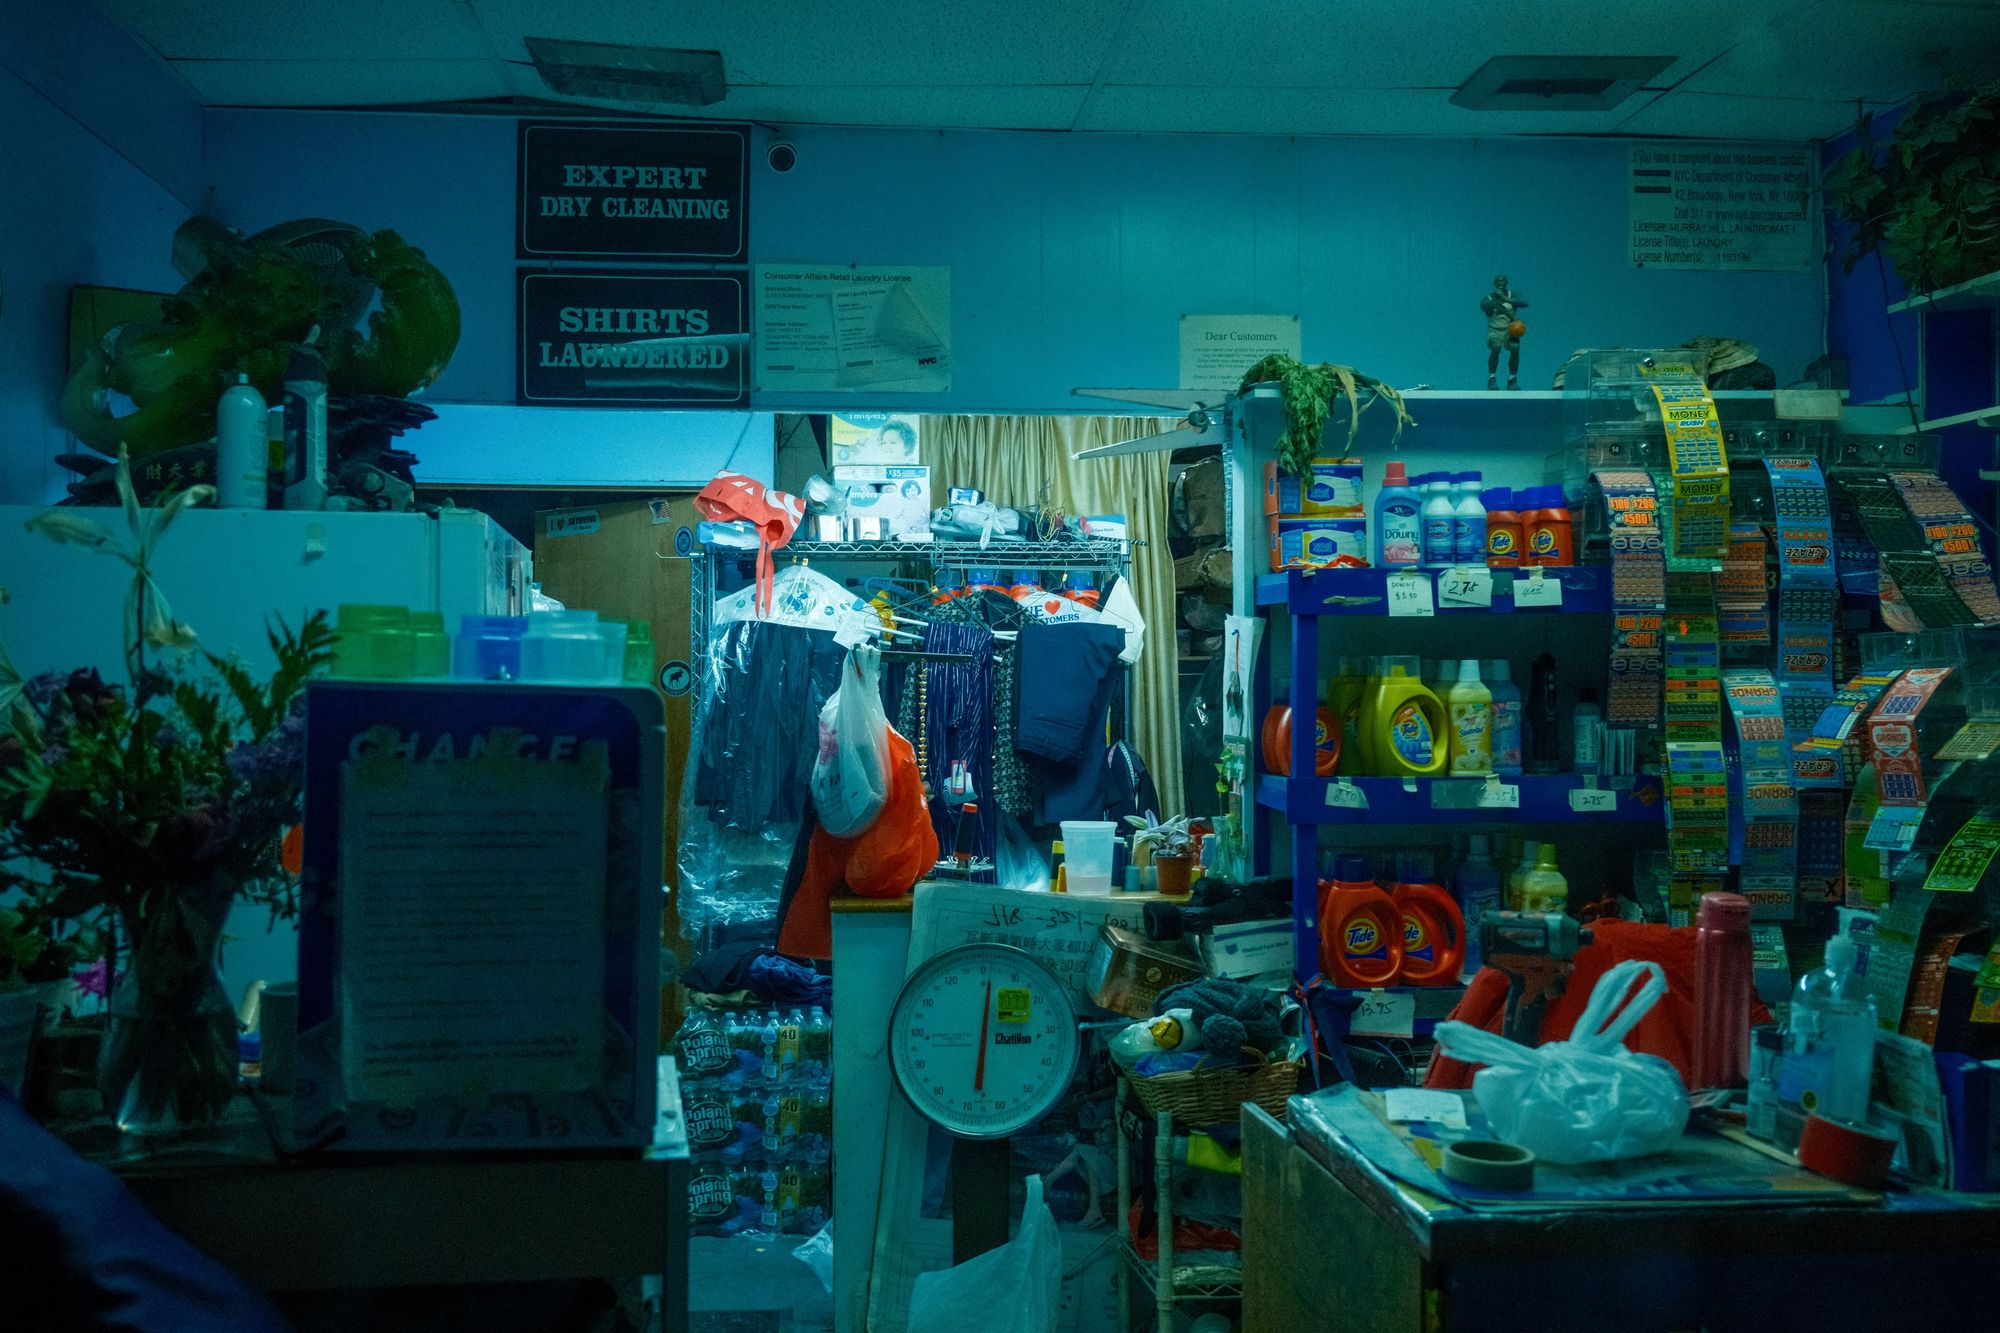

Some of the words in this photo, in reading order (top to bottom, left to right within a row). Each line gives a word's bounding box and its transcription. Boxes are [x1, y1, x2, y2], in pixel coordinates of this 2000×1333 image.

[563, 165, 706, 189] EXPERT
[1674, 170, 1690, 182] NYC
[1692, 170, 1734, 184] Department
[1745, 172, 1781, 184] Consumer
[1674, 189, 1684, 200] 42
[1728, 191, 1745, 201] New
[1768, 191, 1779, 201] NY
[541, 196, 591, 217] DRY
[602, 197, 730, 220] CLEANING
[1669, 223, 1706, 233] MURRAY
[1709, 224, 1726, 233] HILL
[1729, 224, 1790, 233] LAUNDROMAT
[1633, 235, 1662, 247] License
[1692, 239, 1735, 248] LAUNDRY
[1633, 251, 1661, 262] License
[765, 272, 803, 280] Consumer
[829, 273, 850, 281] Retail
[852, 274, 880, 283] Laundry
[560, 307, 709, 334] SHIRTS
[1205, 331, 1228, 341] Dear
[1229, 330, 1278, 341] Customers
[540, 342, 729, 369] LAUNDERED
[1670, 410, 1709, 419] MONEY
[1680, 484, 1722, 494] MONEY
[1609, 498, 1630, 510] $100
[1632, 497, 1655, 509] $200
[1688, 495, 1714, 503] RUSH
[1624, 513, 1653, 525] $500!
[1385, 528, 1418, 542] Downy
[1951, 525, 1974, 536] $200
[1490, 535, 1510, 549] Tide
[1943, 540, 1974, 552] $500!
[1785, 547, 1825, 558] CRAZE
[1784, 655, 1825, 665] CRAZE
[1729, 687, 1778, 698] GRANDE
[1793, 760, 1838, 771] CRAZE
[1747, 787, 1796, 799] GRANDE
[1348, 927, 1375, 947] Tide
[981, 966, 985, 974] 0
[944, 976, 958, 984] 120
[1011, 974, 1019, 982] 10
[922, 998, 934, 1007] 110
[1033, 996, 1043, 1004] 20
[781, 1029, 796, 1040] 40
[911, 1029, 924, 1037] 100
[1045, 1025, 1056, 1034] 30
[995, 1032, 1032, 1045] Chatillon
[685, 1045, 732, 1067] Spring
[1041, 1057, 1052, 1066] 40
[915, 1060, 925, 1069] 90
[933, 1087, 944, 1096] 80
[1024, 1085, 1033, 1093] 50
[782, 1101, 797, 1113] 40
[962, 1101, 973, 1111] 70
[995, 1101, 1006, 1110] 60
[687, 1117, 733, 1139] Spring
[782, 1175, 797, 1187] 40
